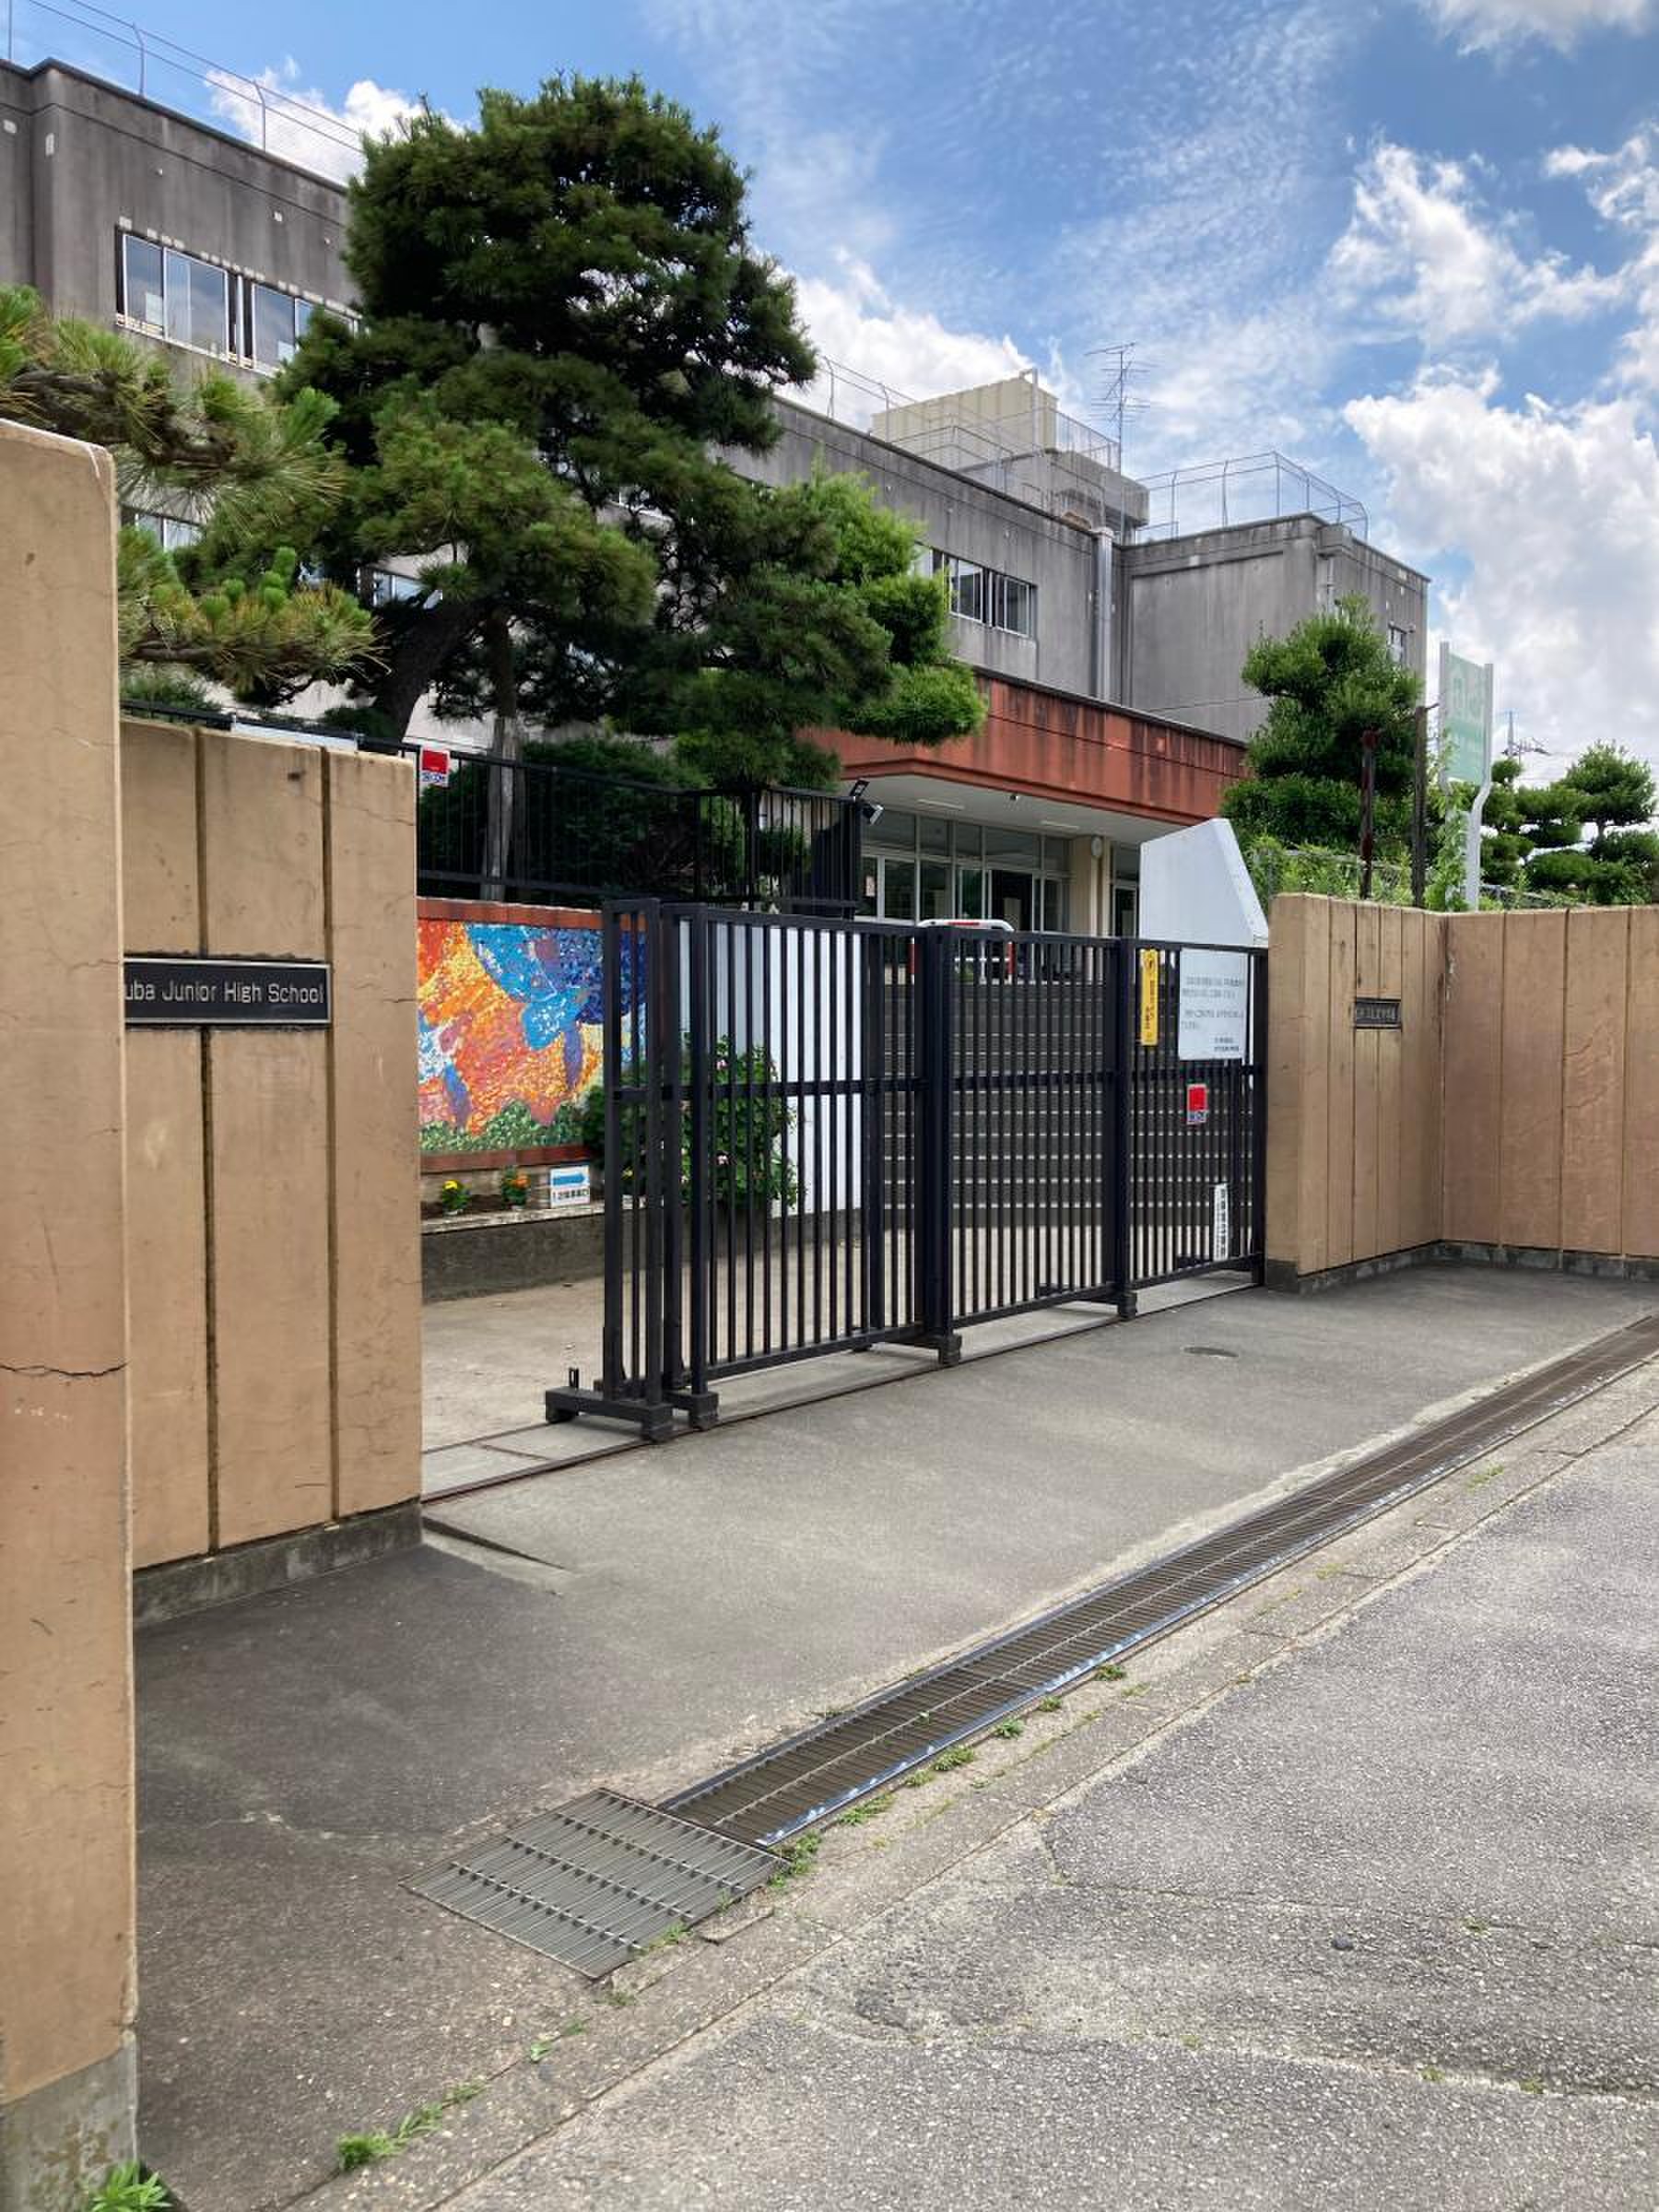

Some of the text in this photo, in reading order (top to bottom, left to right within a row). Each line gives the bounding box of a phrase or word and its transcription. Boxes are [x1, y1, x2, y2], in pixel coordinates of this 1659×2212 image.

[161, 980, 218, 1003] Junior
[223, 981, 263, 1004] High
[267, 982, 324, 1004] School
